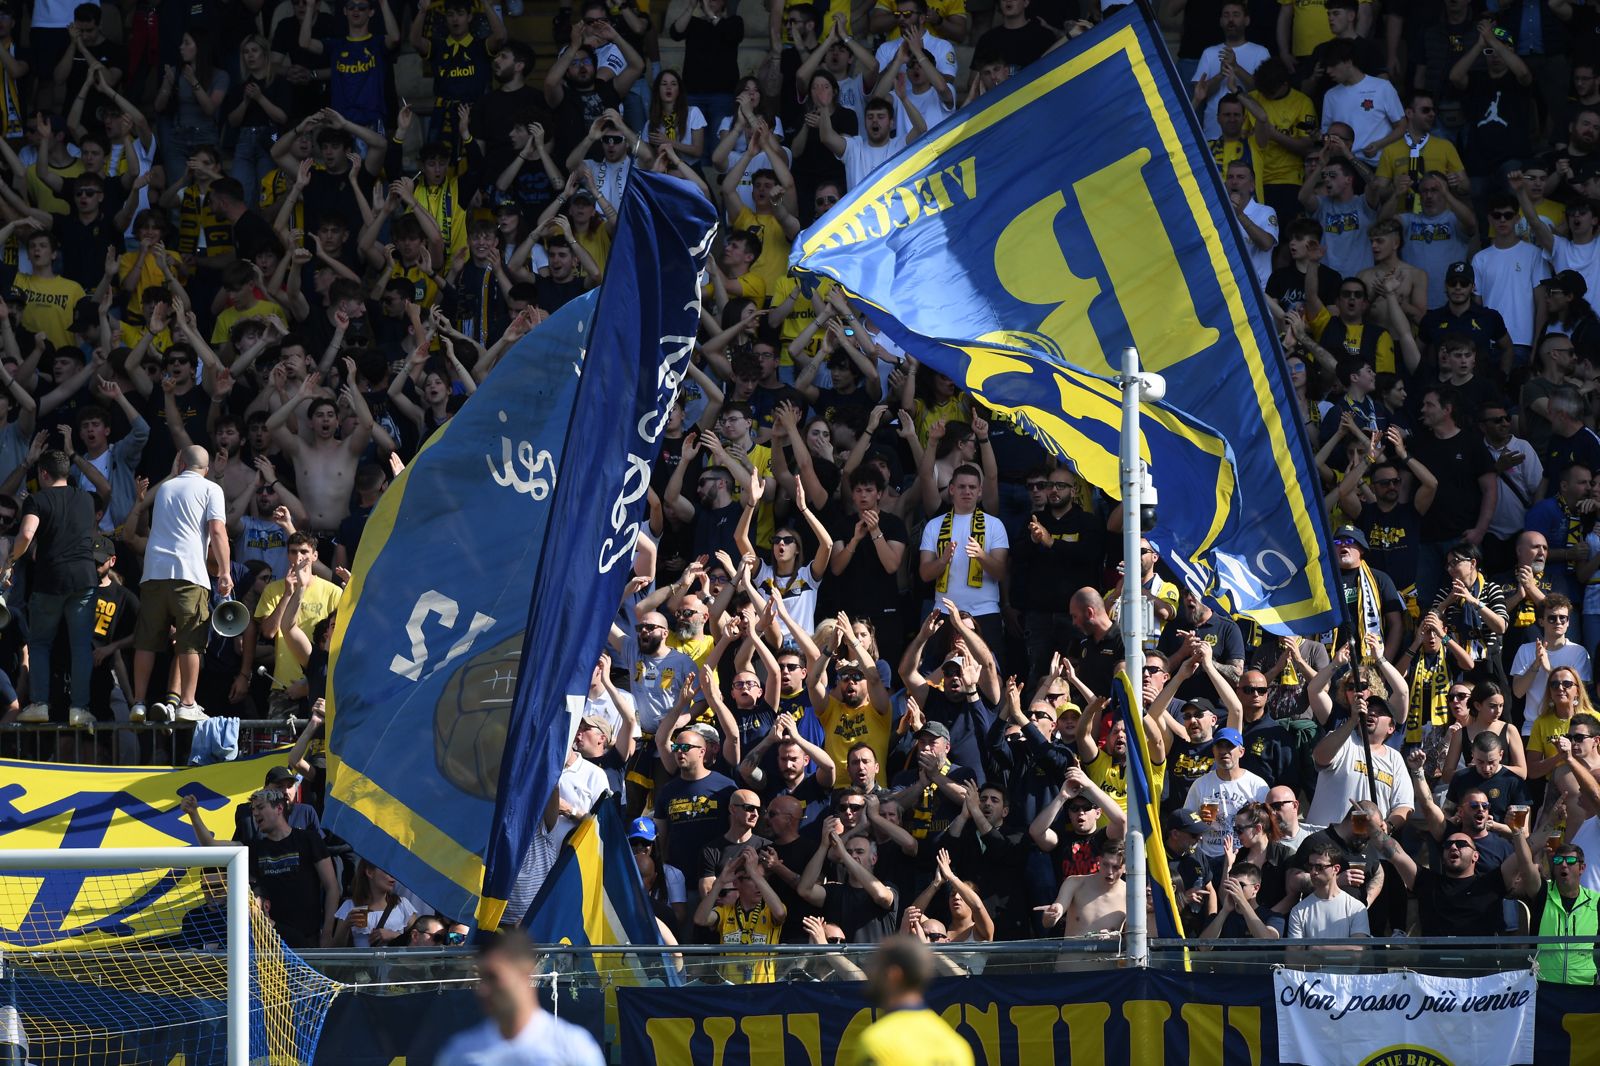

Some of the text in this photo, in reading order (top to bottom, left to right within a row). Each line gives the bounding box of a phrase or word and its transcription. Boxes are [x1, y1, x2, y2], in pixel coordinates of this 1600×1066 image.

[1281, 979, 1530, 1021] Non posso più venire
